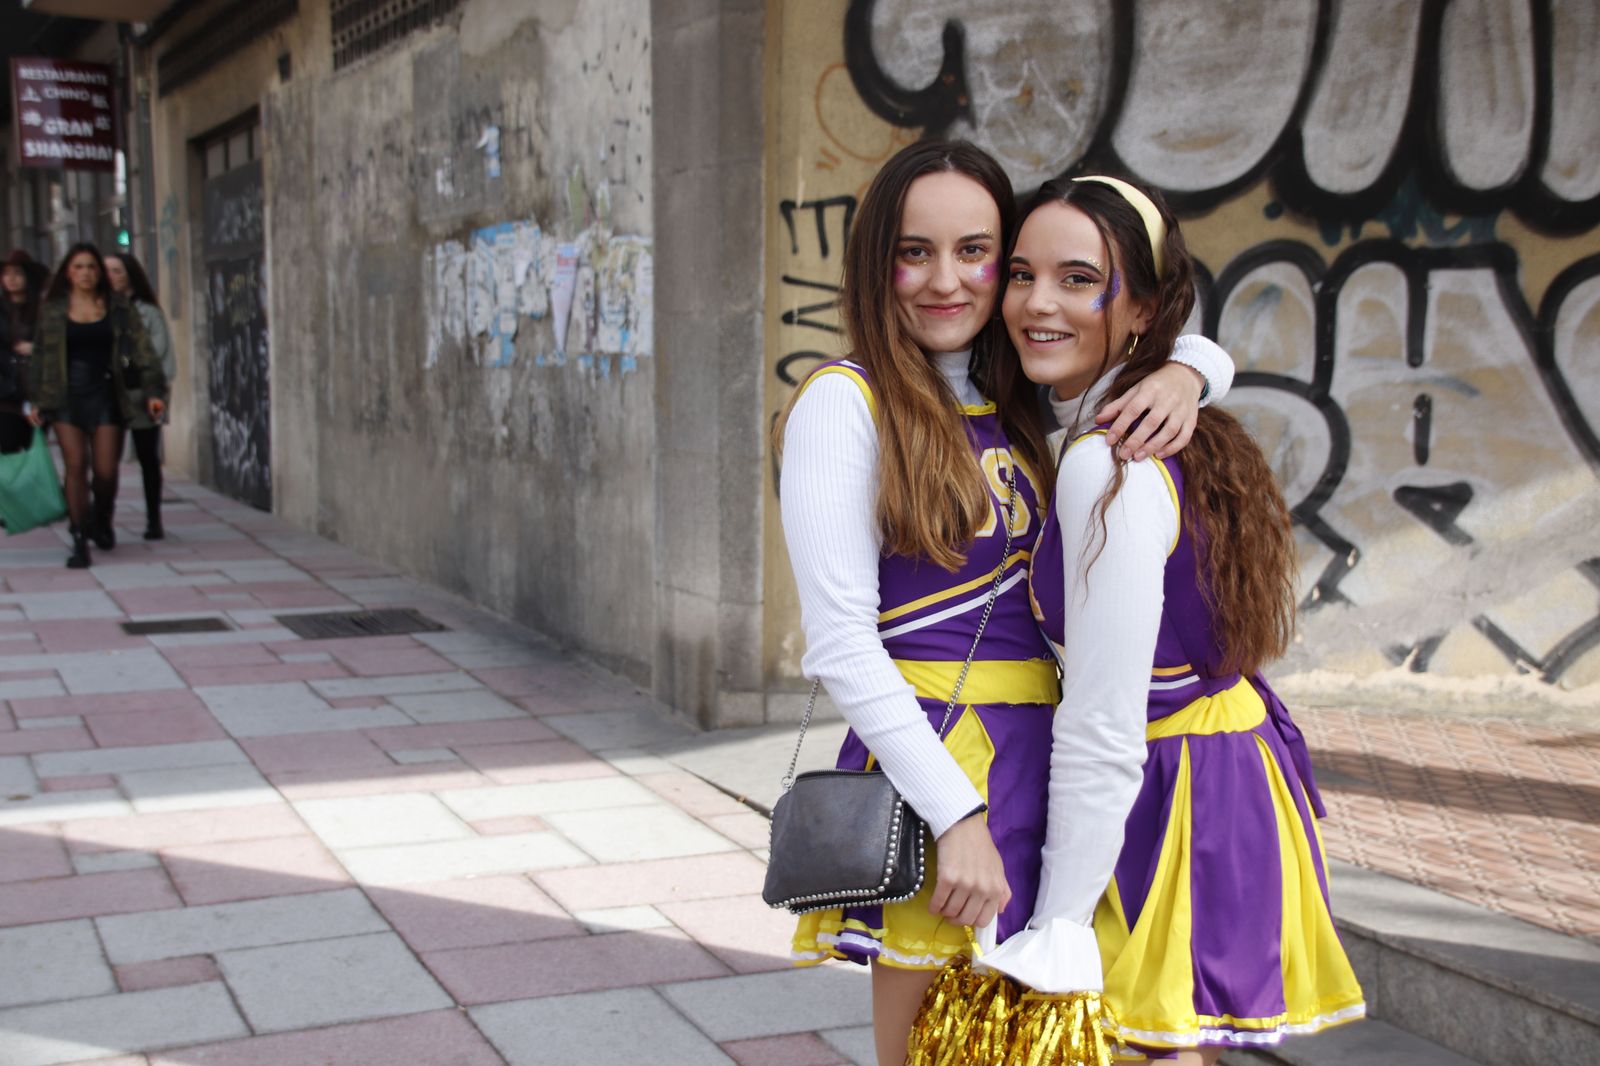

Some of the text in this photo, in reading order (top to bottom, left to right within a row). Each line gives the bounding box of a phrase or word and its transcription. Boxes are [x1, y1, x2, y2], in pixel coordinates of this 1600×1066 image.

[43, 83, 90, 101] CHINO
[43, 117, 94, 137] GRAN
[23, 139, 113, 161] SHANGHAI
